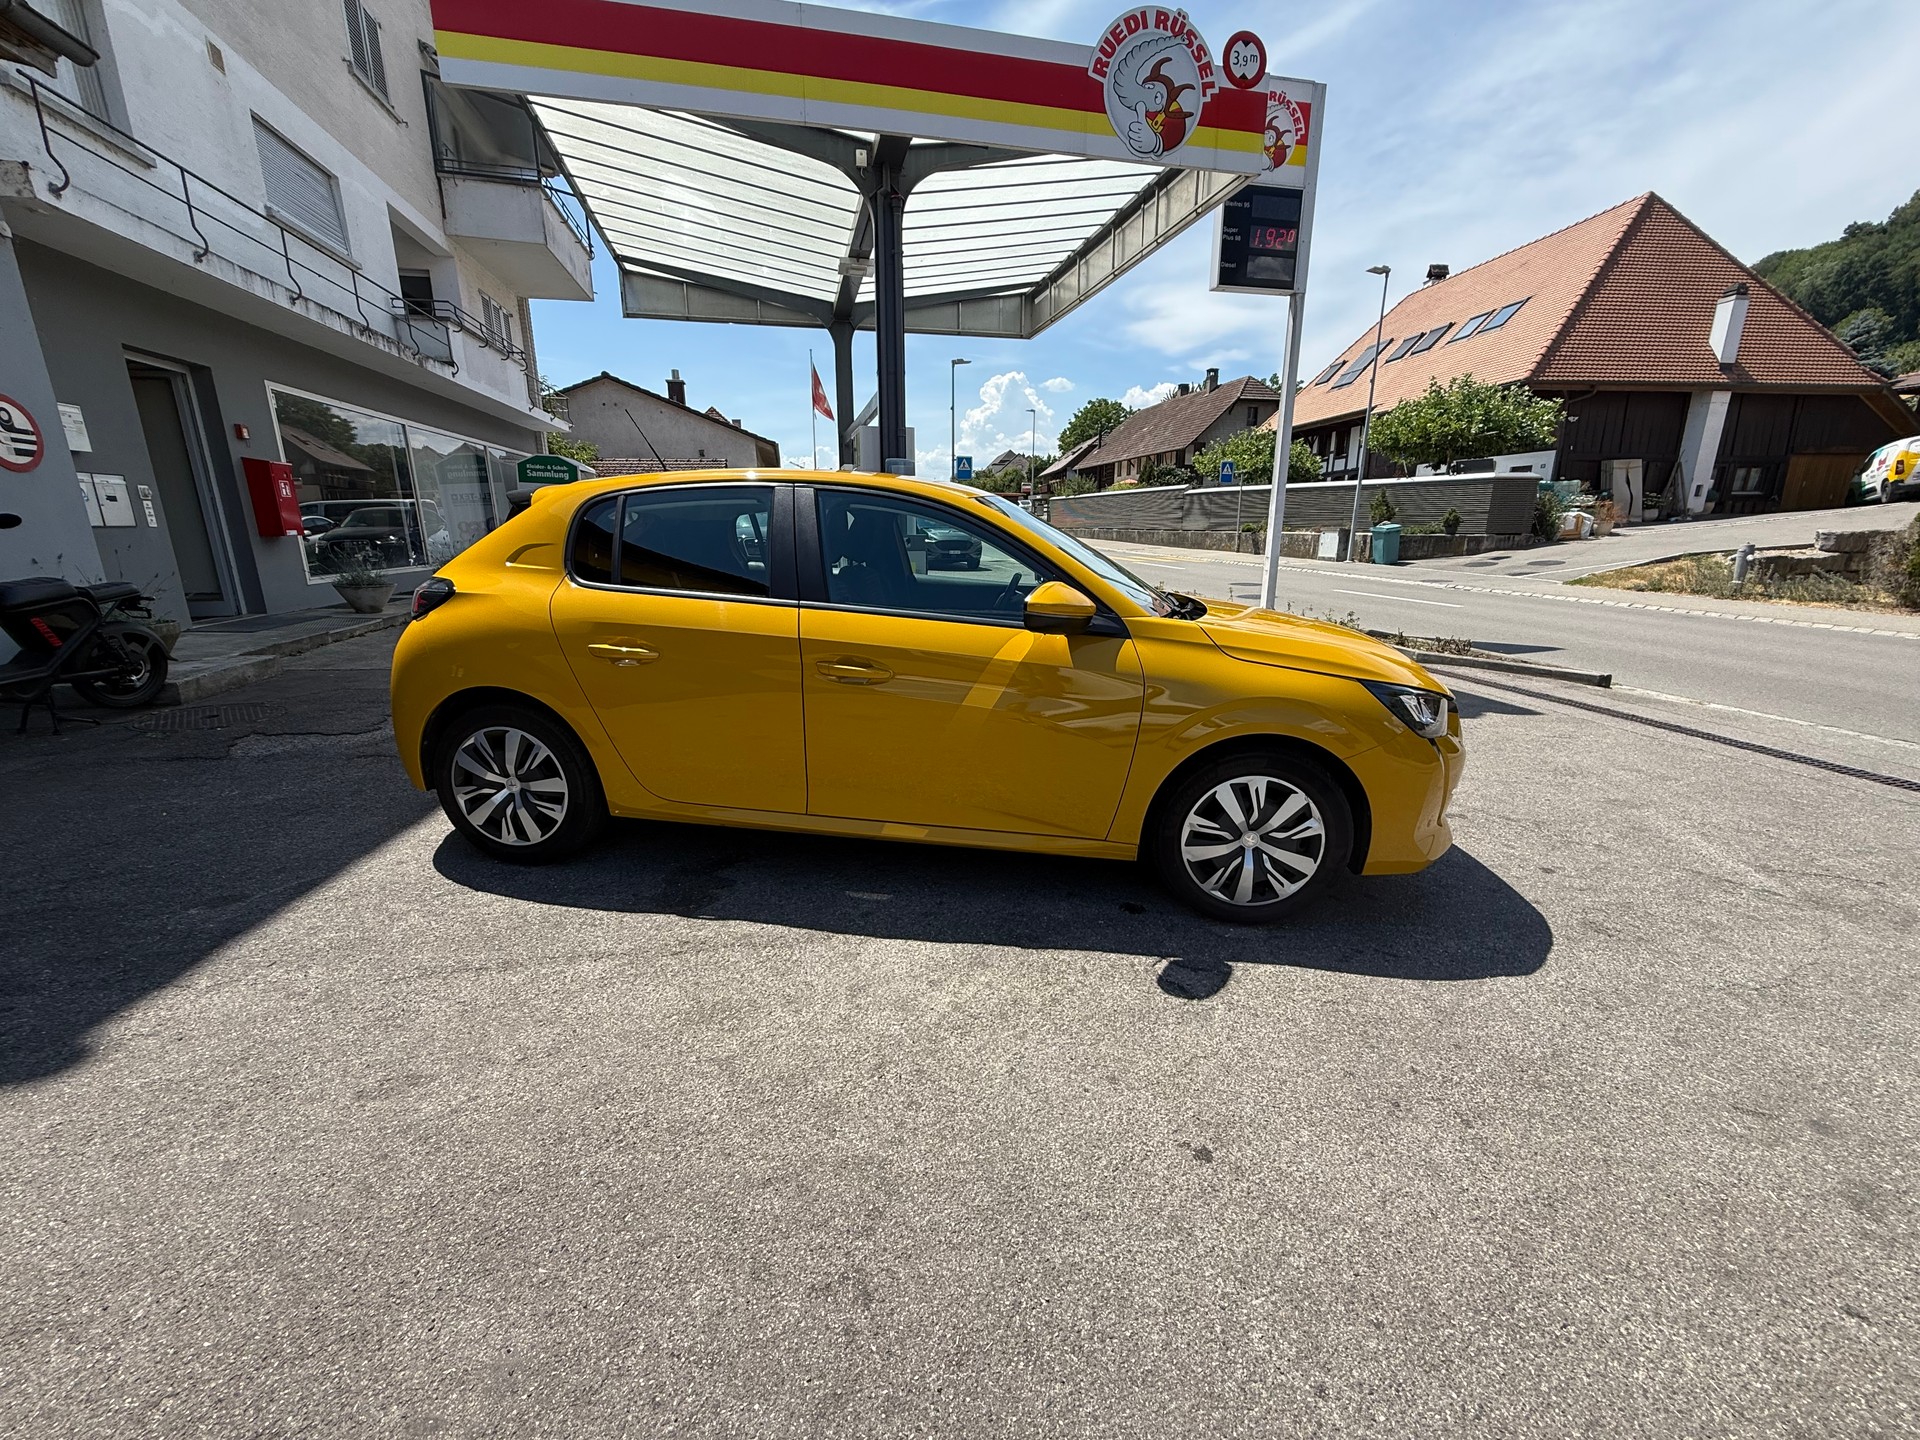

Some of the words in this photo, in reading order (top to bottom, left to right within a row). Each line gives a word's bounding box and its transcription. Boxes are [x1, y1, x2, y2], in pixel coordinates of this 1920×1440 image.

[1092, 10, 1148, 78] RUEDI
[1154, 9, 1215, 97] RÜSSEL
[1269, 90, 1303, 137] RÜSSEL
[1254, 227, 1296, 249] 1.920
[526, 469, 569, 480] Sammlung
